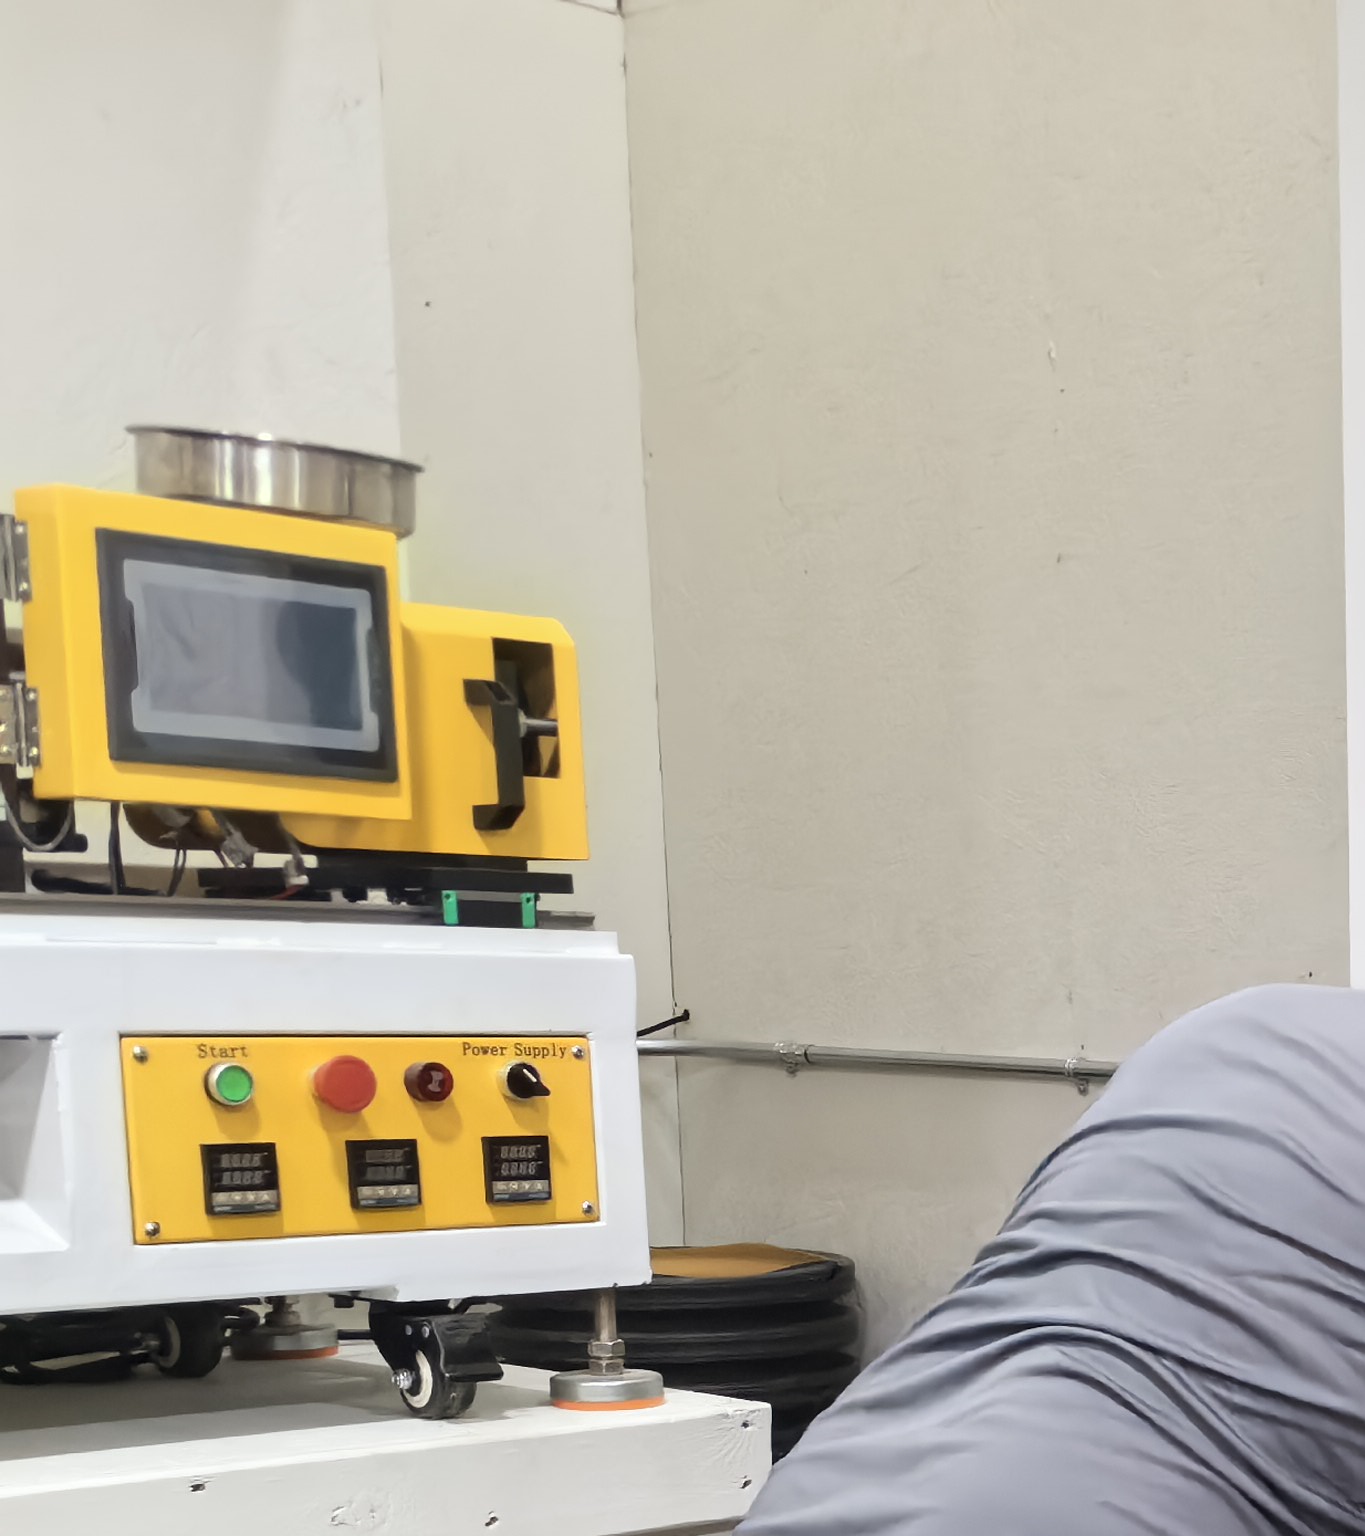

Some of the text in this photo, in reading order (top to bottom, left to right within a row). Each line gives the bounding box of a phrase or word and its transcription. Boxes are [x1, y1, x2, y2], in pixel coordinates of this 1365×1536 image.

[197, 1043, 249, 1059] Start
[462, 1042, 567, 1059] Power Supply
